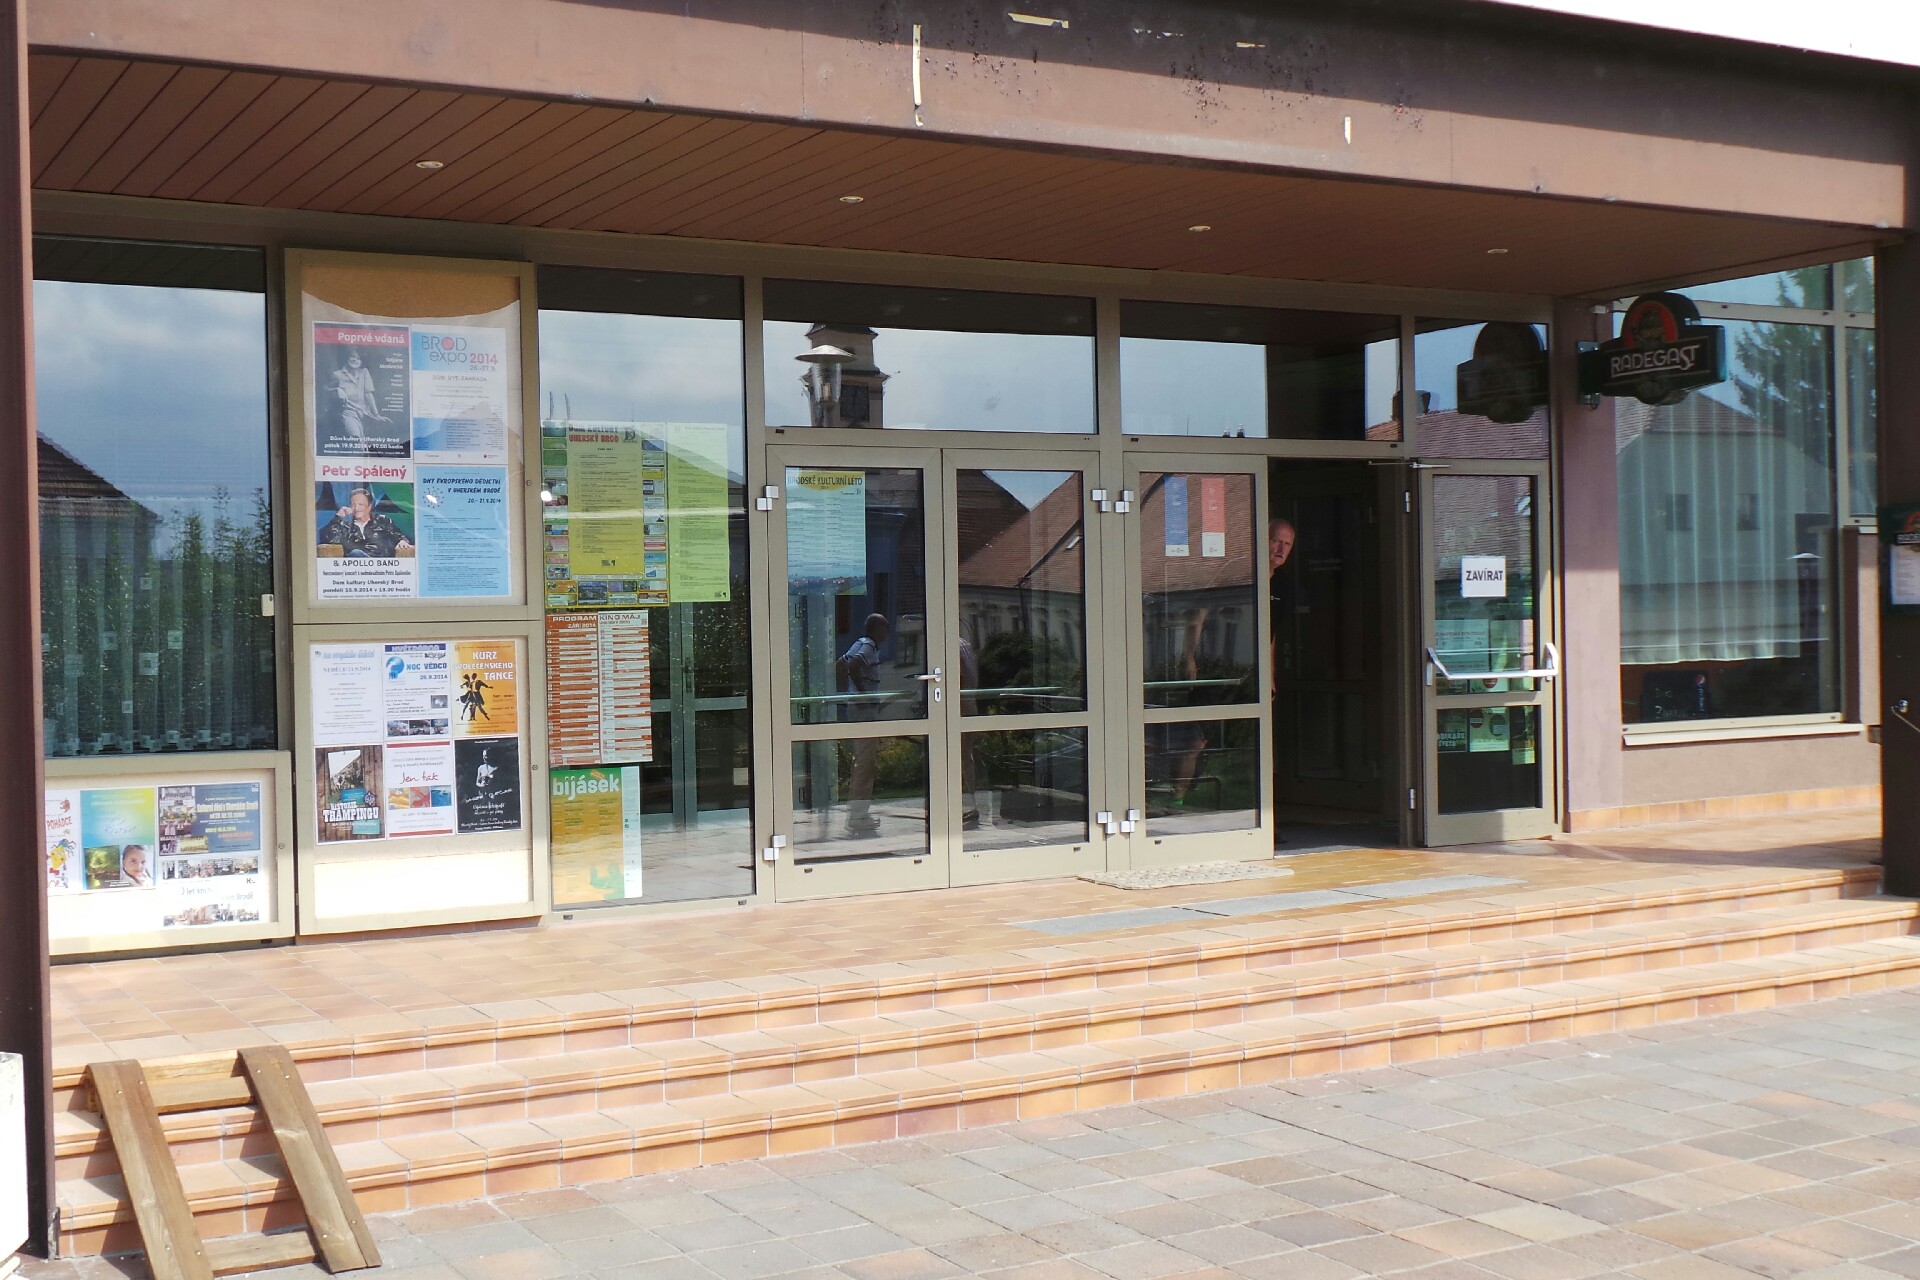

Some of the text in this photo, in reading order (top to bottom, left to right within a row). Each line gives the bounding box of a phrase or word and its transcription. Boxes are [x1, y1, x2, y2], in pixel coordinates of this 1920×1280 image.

[338, 331, 405, 344] Poprvé vdaná
[421, 335, 467, 351] BROD
[429, 350, 498, 365] expo 2014
[1610, 344, 1700, 378] RADEGAST
[322, 465, 407, 479] Petr Spálený
[1465, 567, 1504, 582] ZAVÍRAT
[472, 651, 497, 660] KURZ
[484, 672, 514, 680] TANCE
[422, 771, 439, 782] tak
[552, 773, 620, 801] bijásek
